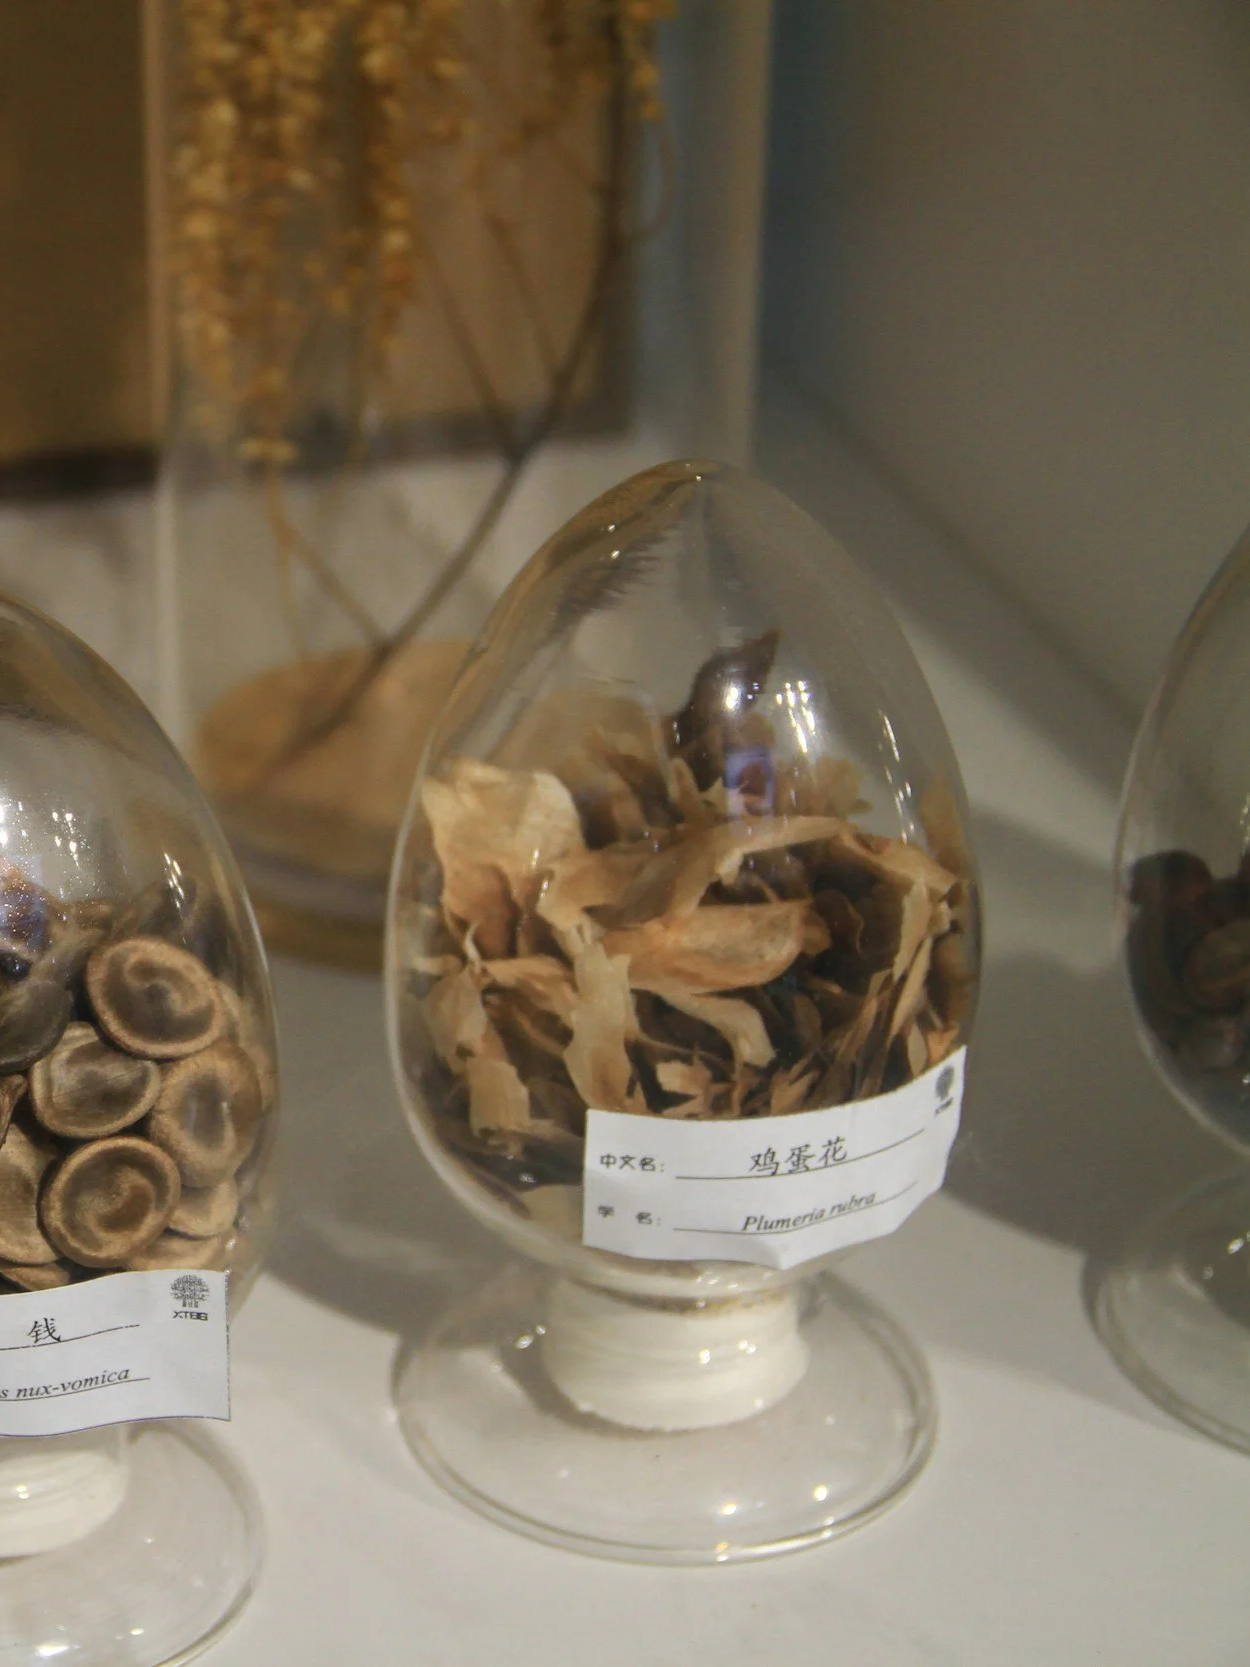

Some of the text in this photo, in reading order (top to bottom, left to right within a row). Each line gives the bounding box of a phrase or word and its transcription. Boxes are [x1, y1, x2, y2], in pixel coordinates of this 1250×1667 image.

[749, 1136, 848, 1177] 鸡蛋花
[741, 1191, 877, 1232] Plumeria rubra
[15, 1368, 131, 1399] nux-vomica
